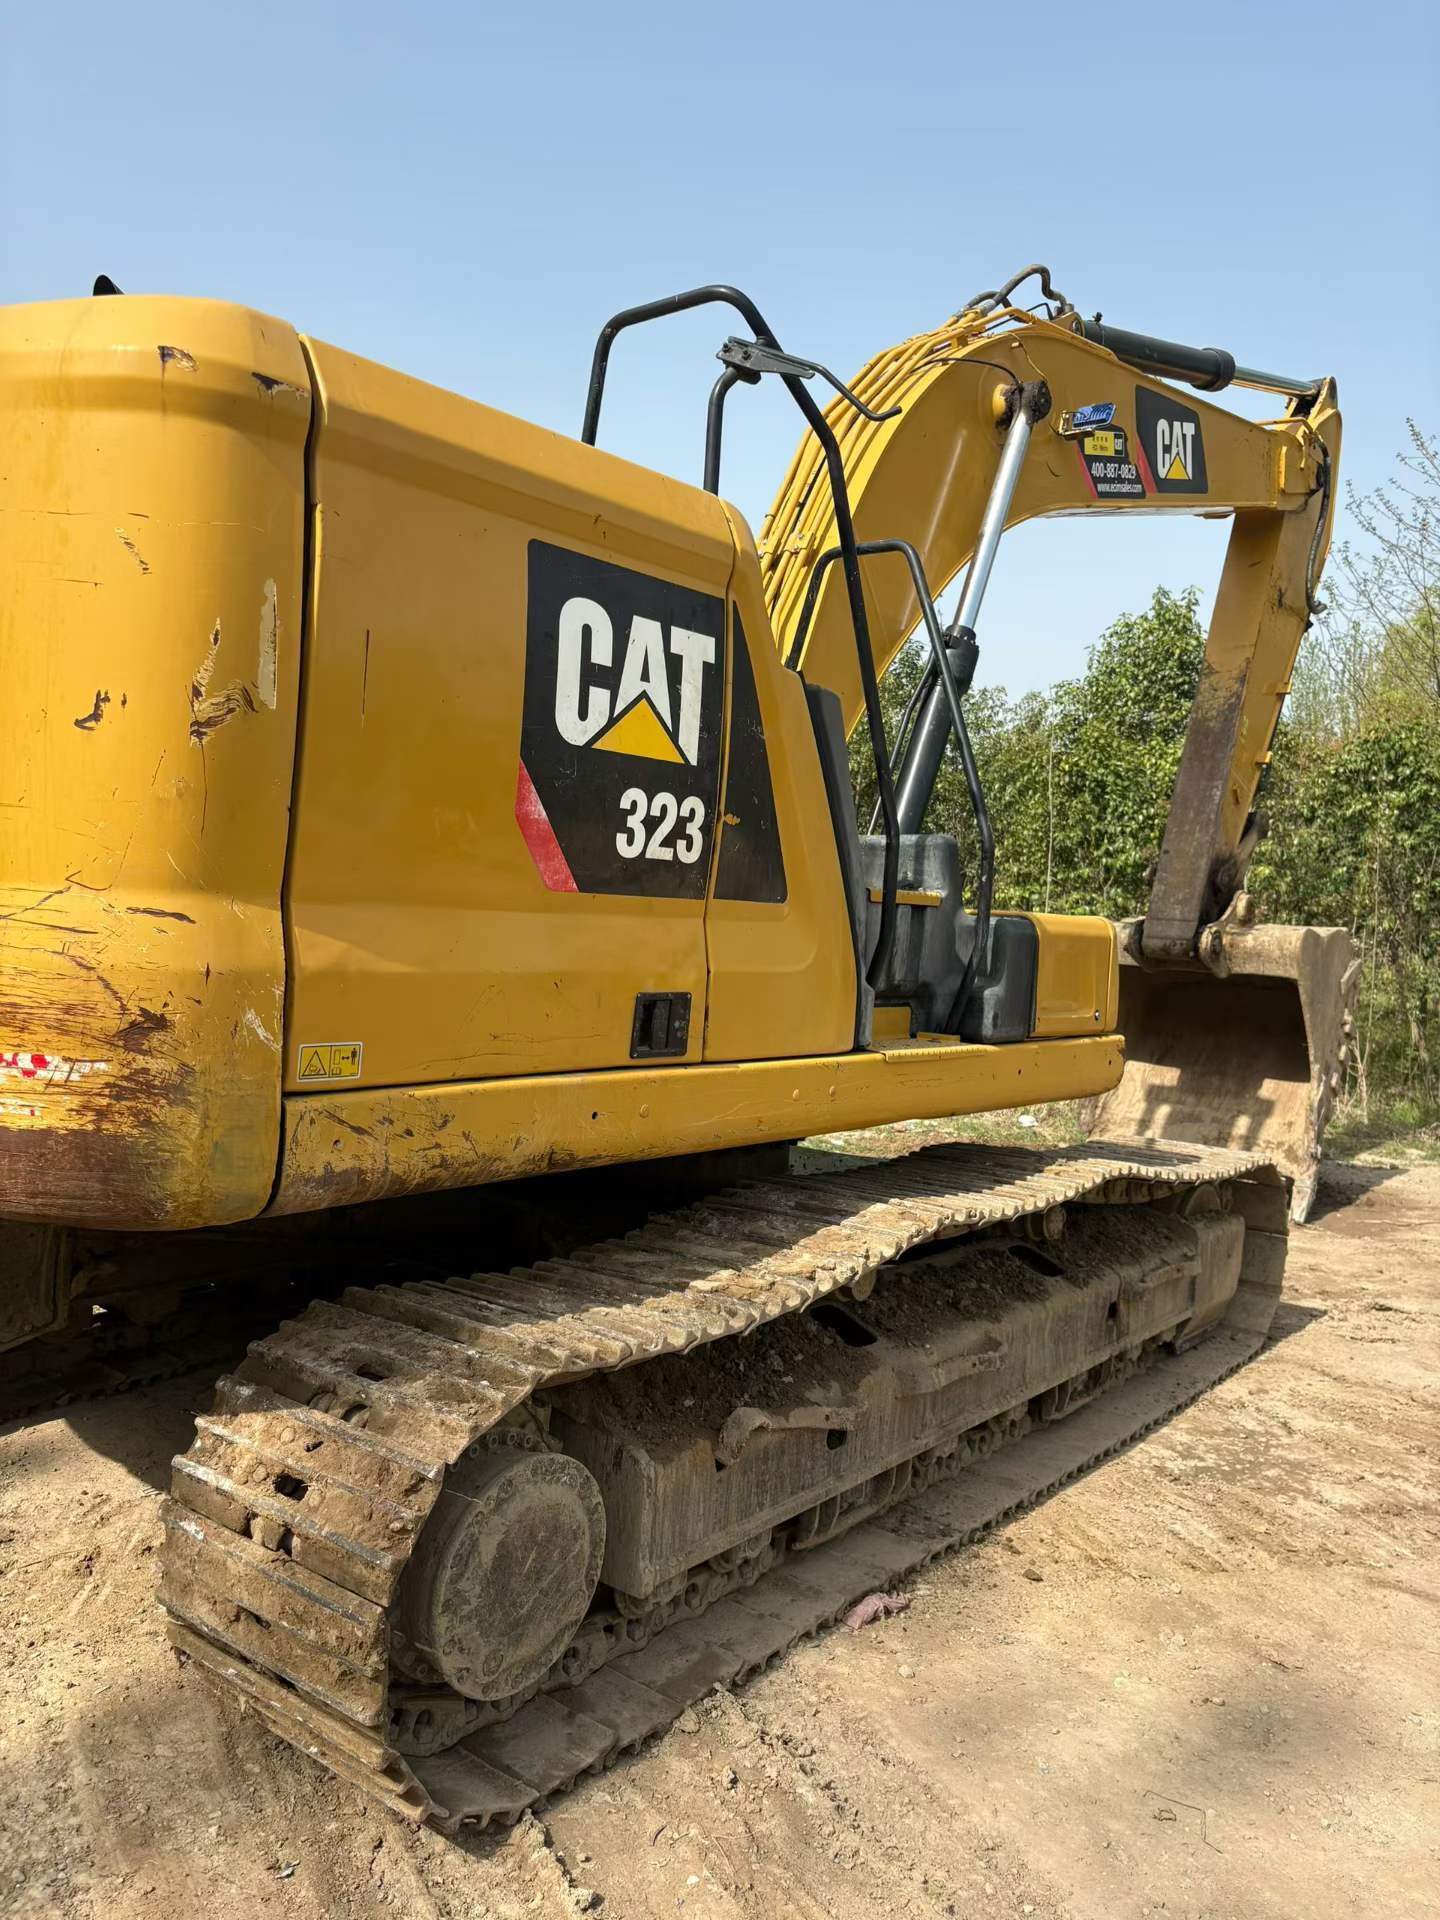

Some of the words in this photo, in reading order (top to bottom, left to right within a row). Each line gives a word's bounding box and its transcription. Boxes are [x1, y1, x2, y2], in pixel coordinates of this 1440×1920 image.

[1156, 418, 1195, 480] CAT
[555, 597, 716, 766] CAT
[615, 787, 705, 864] 323
